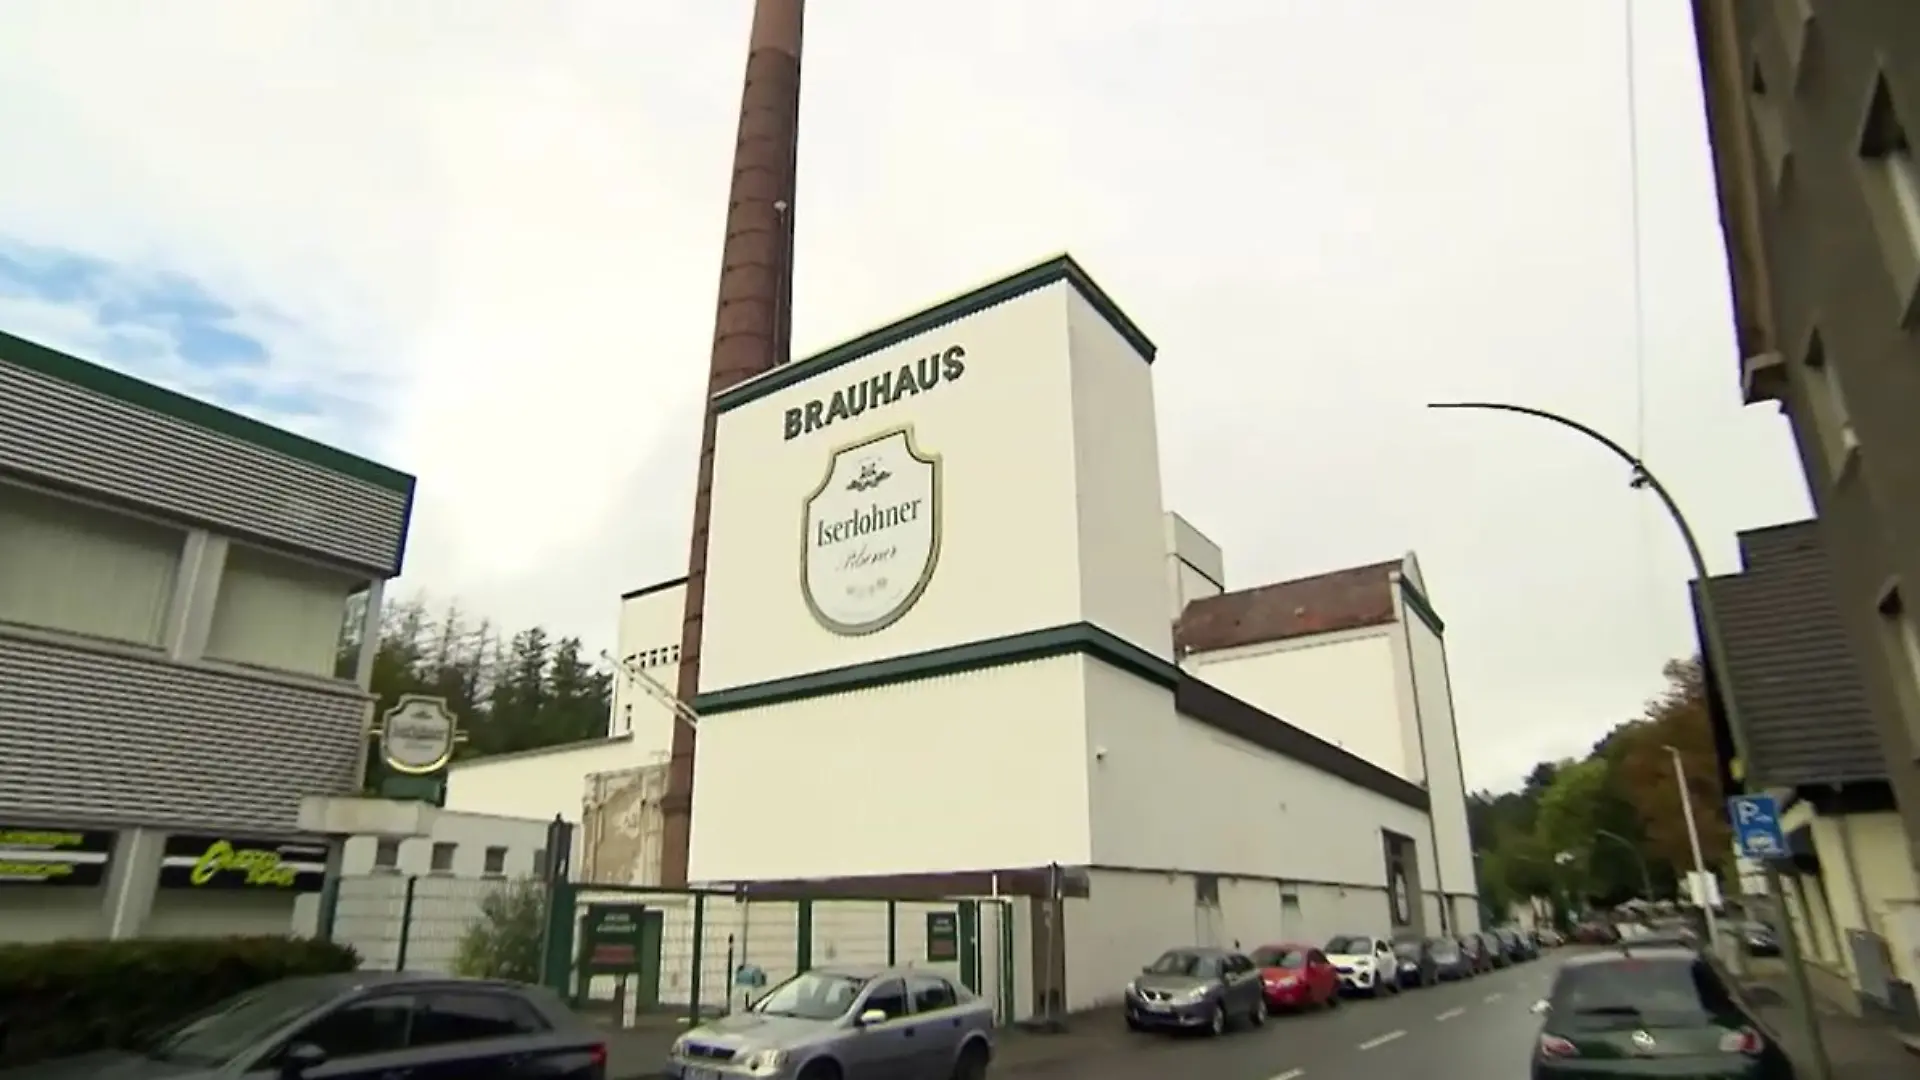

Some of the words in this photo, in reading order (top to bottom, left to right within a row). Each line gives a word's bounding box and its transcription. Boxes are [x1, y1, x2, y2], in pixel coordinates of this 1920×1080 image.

[784, 345, 966, 441] BRAUHAUS
[817, 498, 922, 547] Iserlohner
[1738, 801, 1760, 825] P
